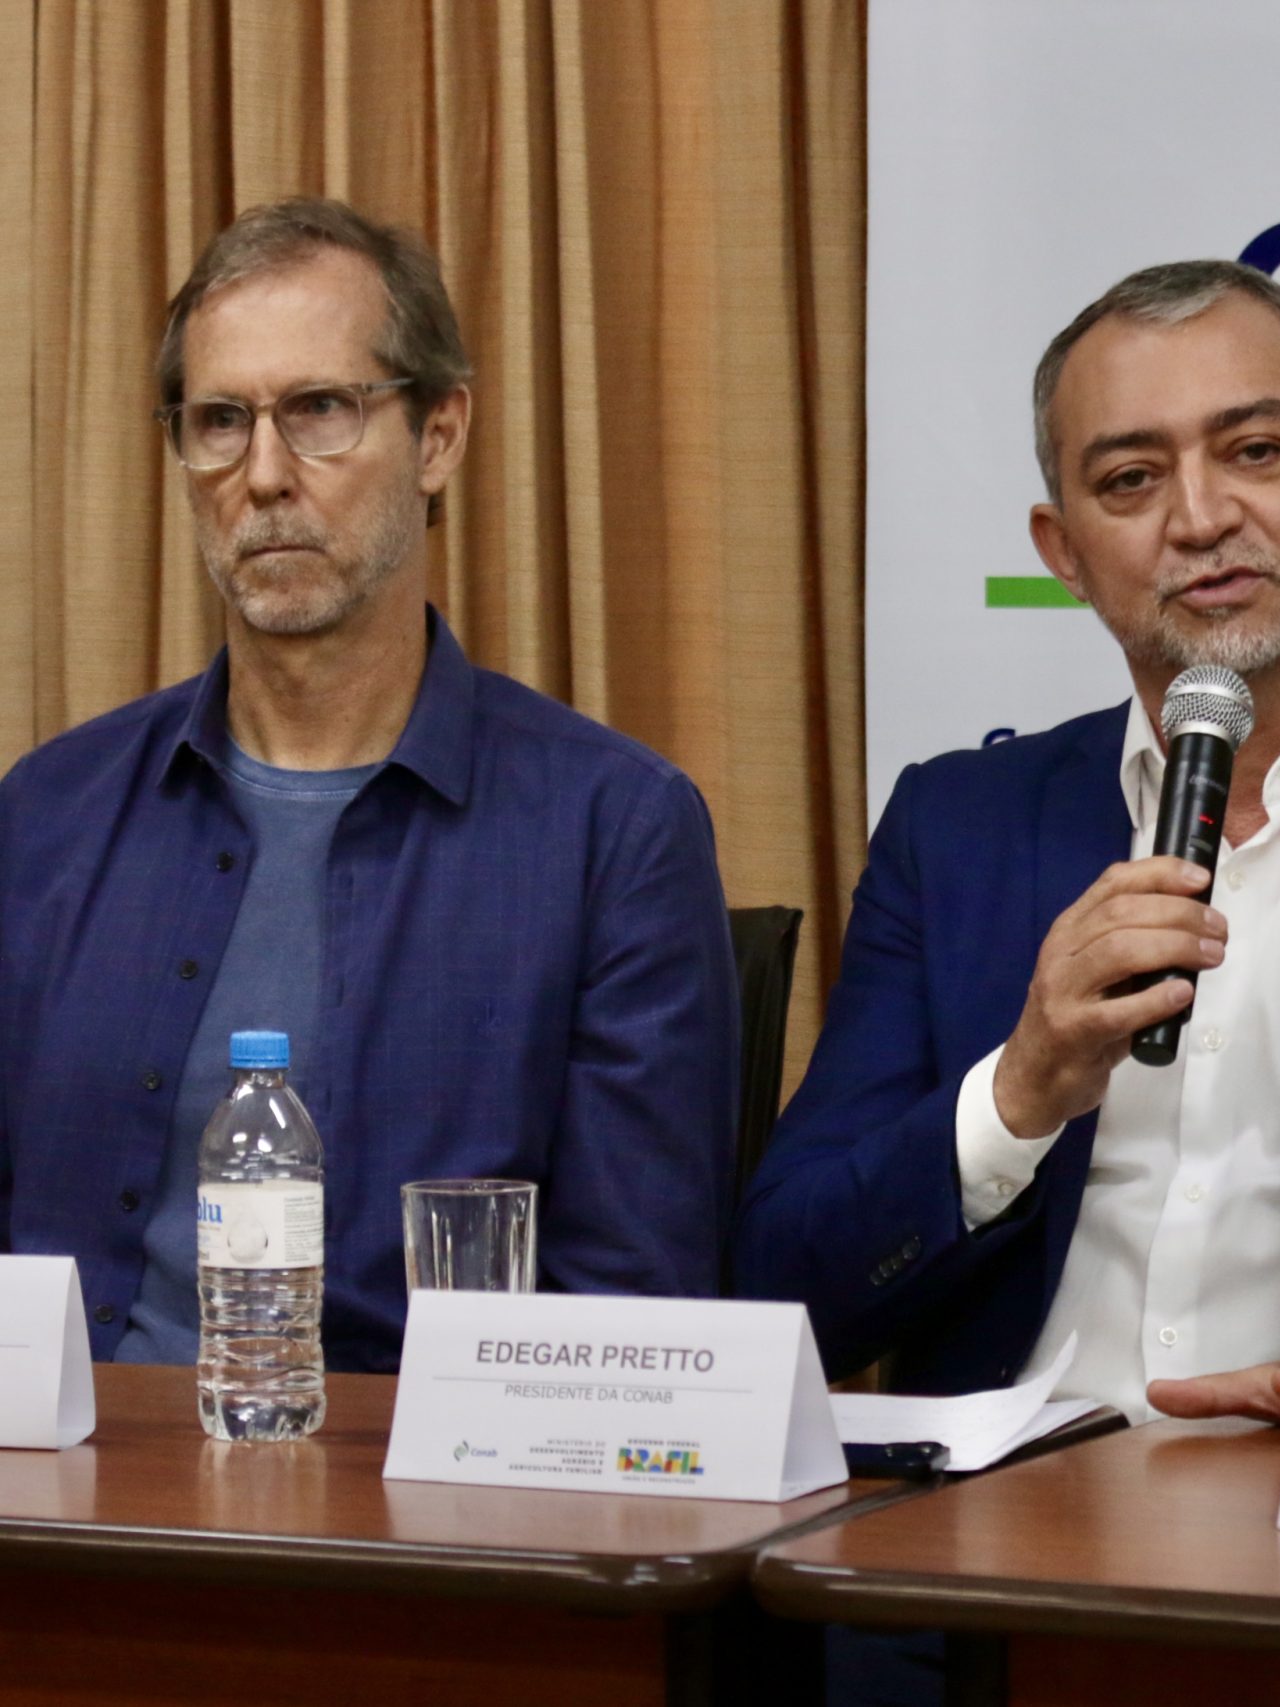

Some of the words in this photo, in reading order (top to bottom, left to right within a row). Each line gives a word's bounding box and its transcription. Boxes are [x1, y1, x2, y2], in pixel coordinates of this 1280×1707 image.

[476, 1340, 592, 1367] EDEGAR
[601, 1345, 715, 1372] PRETTO
[504, 1384, 594, 1401] PRESIDENTE
[597, 1387, 619, 1401] DA
[623, 1388, 673, 1404] CONAB
[617, 1448, 704, 1475] BRASIL
